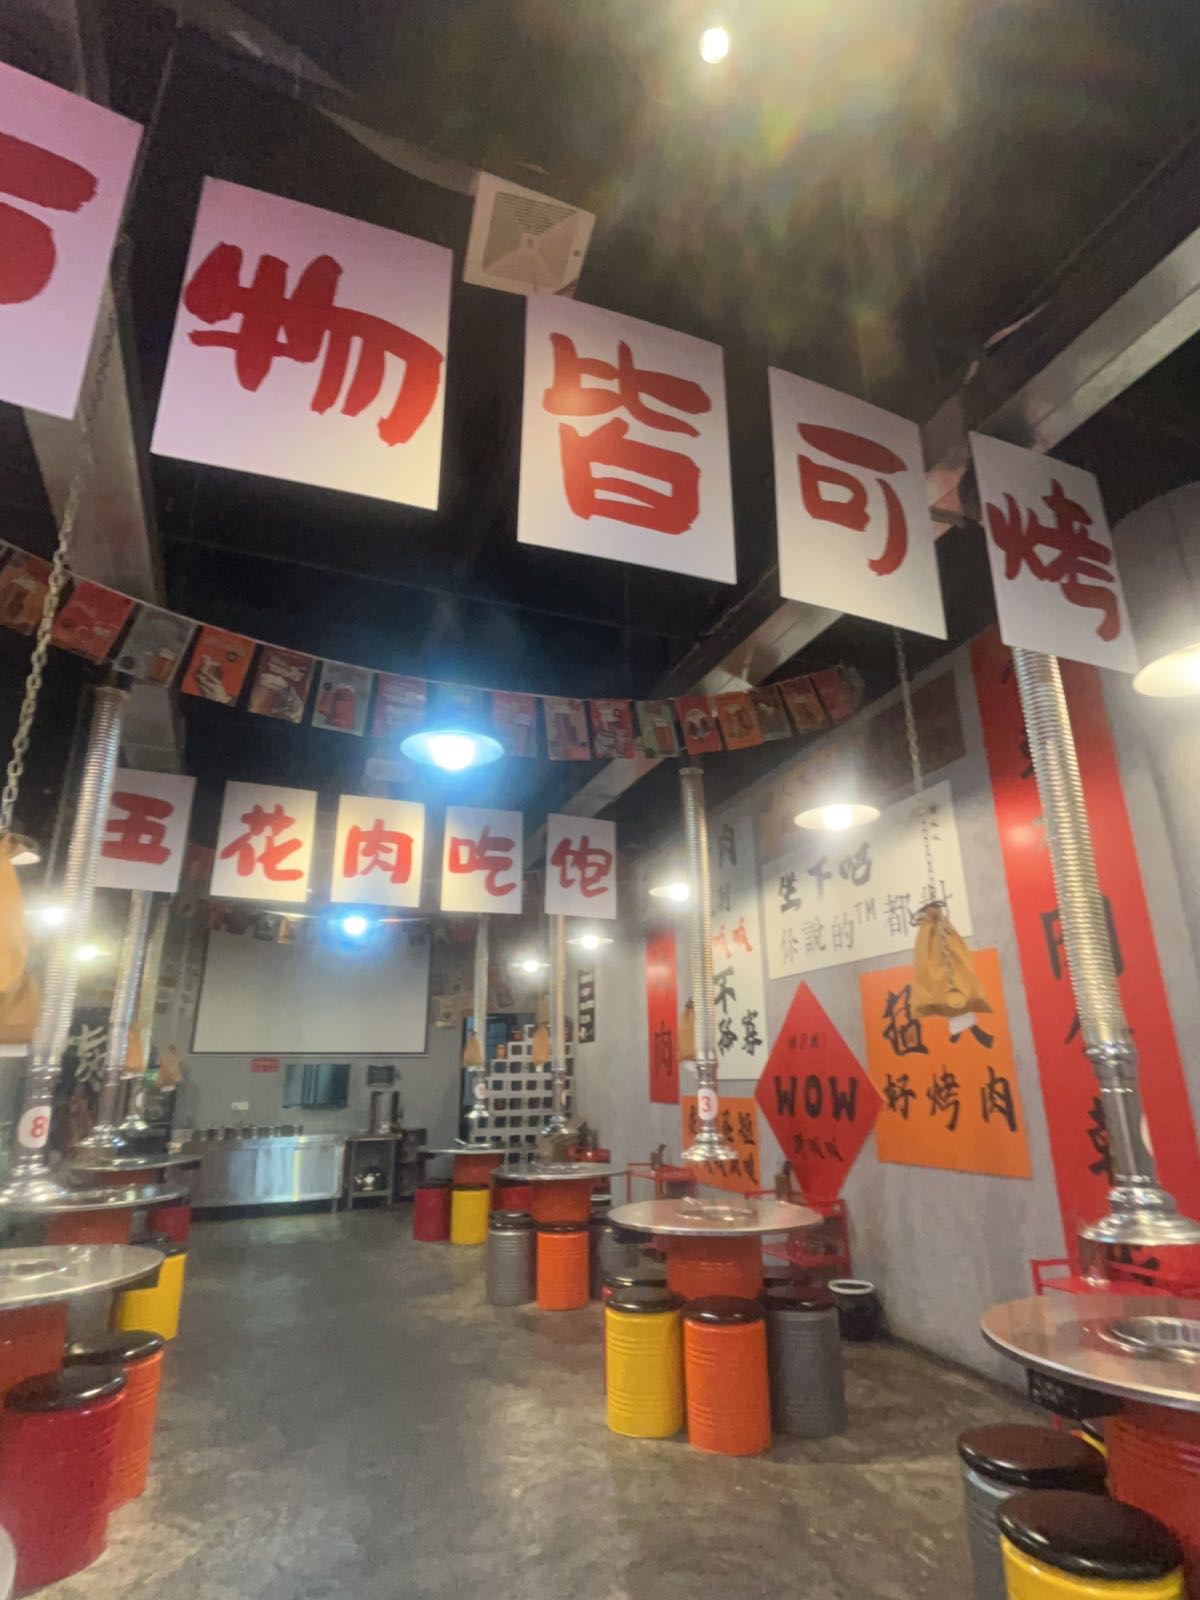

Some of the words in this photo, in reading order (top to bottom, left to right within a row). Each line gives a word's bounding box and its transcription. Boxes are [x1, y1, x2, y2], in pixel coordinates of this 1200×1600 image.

[184, 242, 444, 447] 物
[542, 331, 712, 535] 皆
[797, 421, 908, 577] 可
[986, 477, 1122, 642] 烤
[101, 791, 174, 865] 五
[220, 804, 304, 881] 花
[343, 819, 413, 884] 肉
[448, 826, 516, 897] 吃
[550, 836, 613, 897] 饱
[31, 1115, 49, 1138] 8
[702, 1095, 712, 1113] 3
[774, 1074, 859, 1122] WOW
[884, 1063, 1017, 1133] 好烤肉
